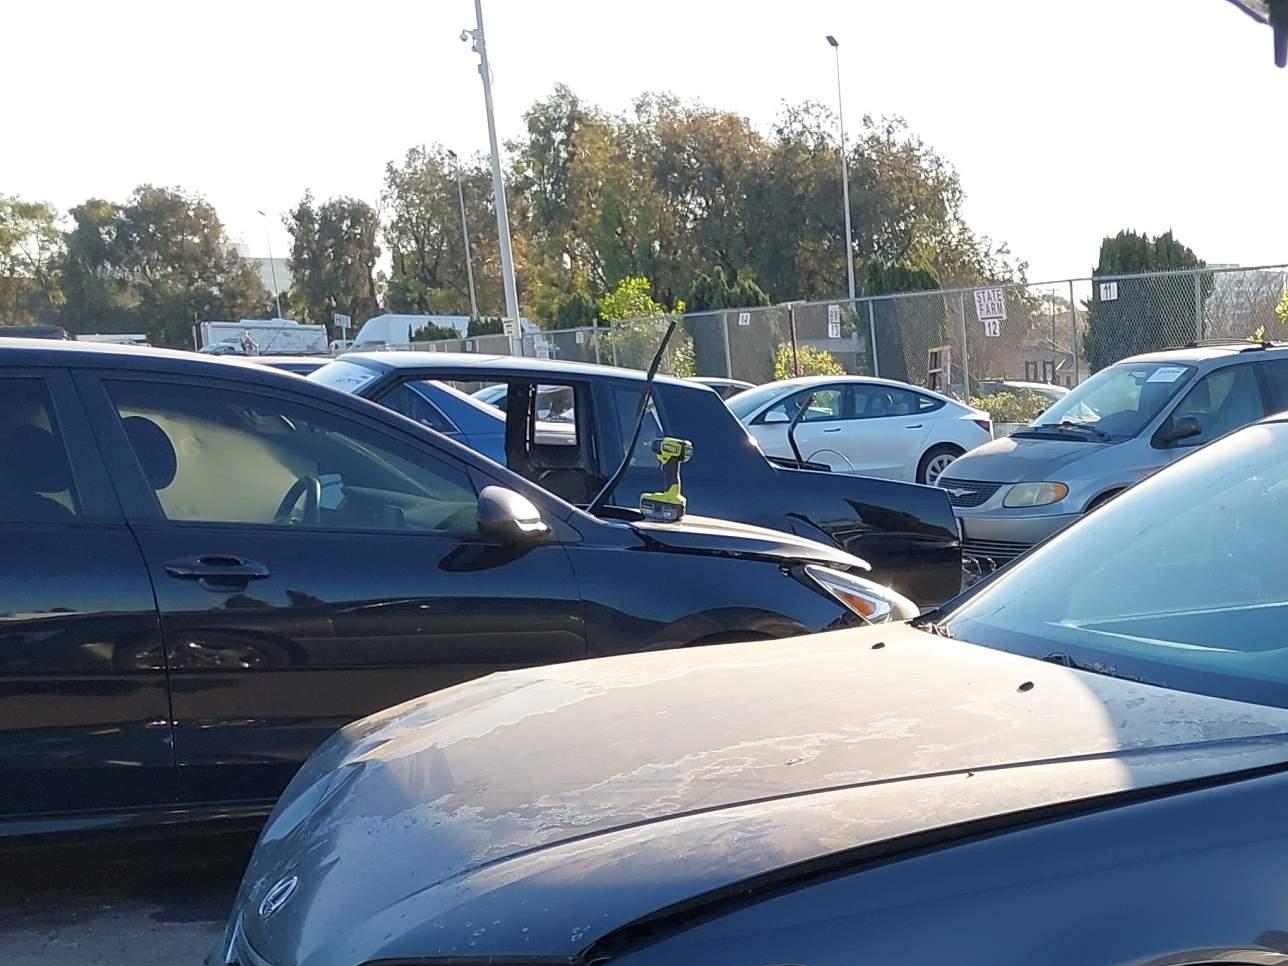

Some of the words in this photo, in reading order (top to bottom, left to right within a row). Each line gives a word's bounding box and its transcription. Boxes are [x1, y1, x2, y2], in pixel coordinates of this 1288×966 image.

[976, 289, 1002, 304] STATE
[1103, 285, 1112, 300] 11
[979, 302, 1004, 316] FARM
[831, 324, 840, 337] 13
[987, 321, 998, 336] 12
